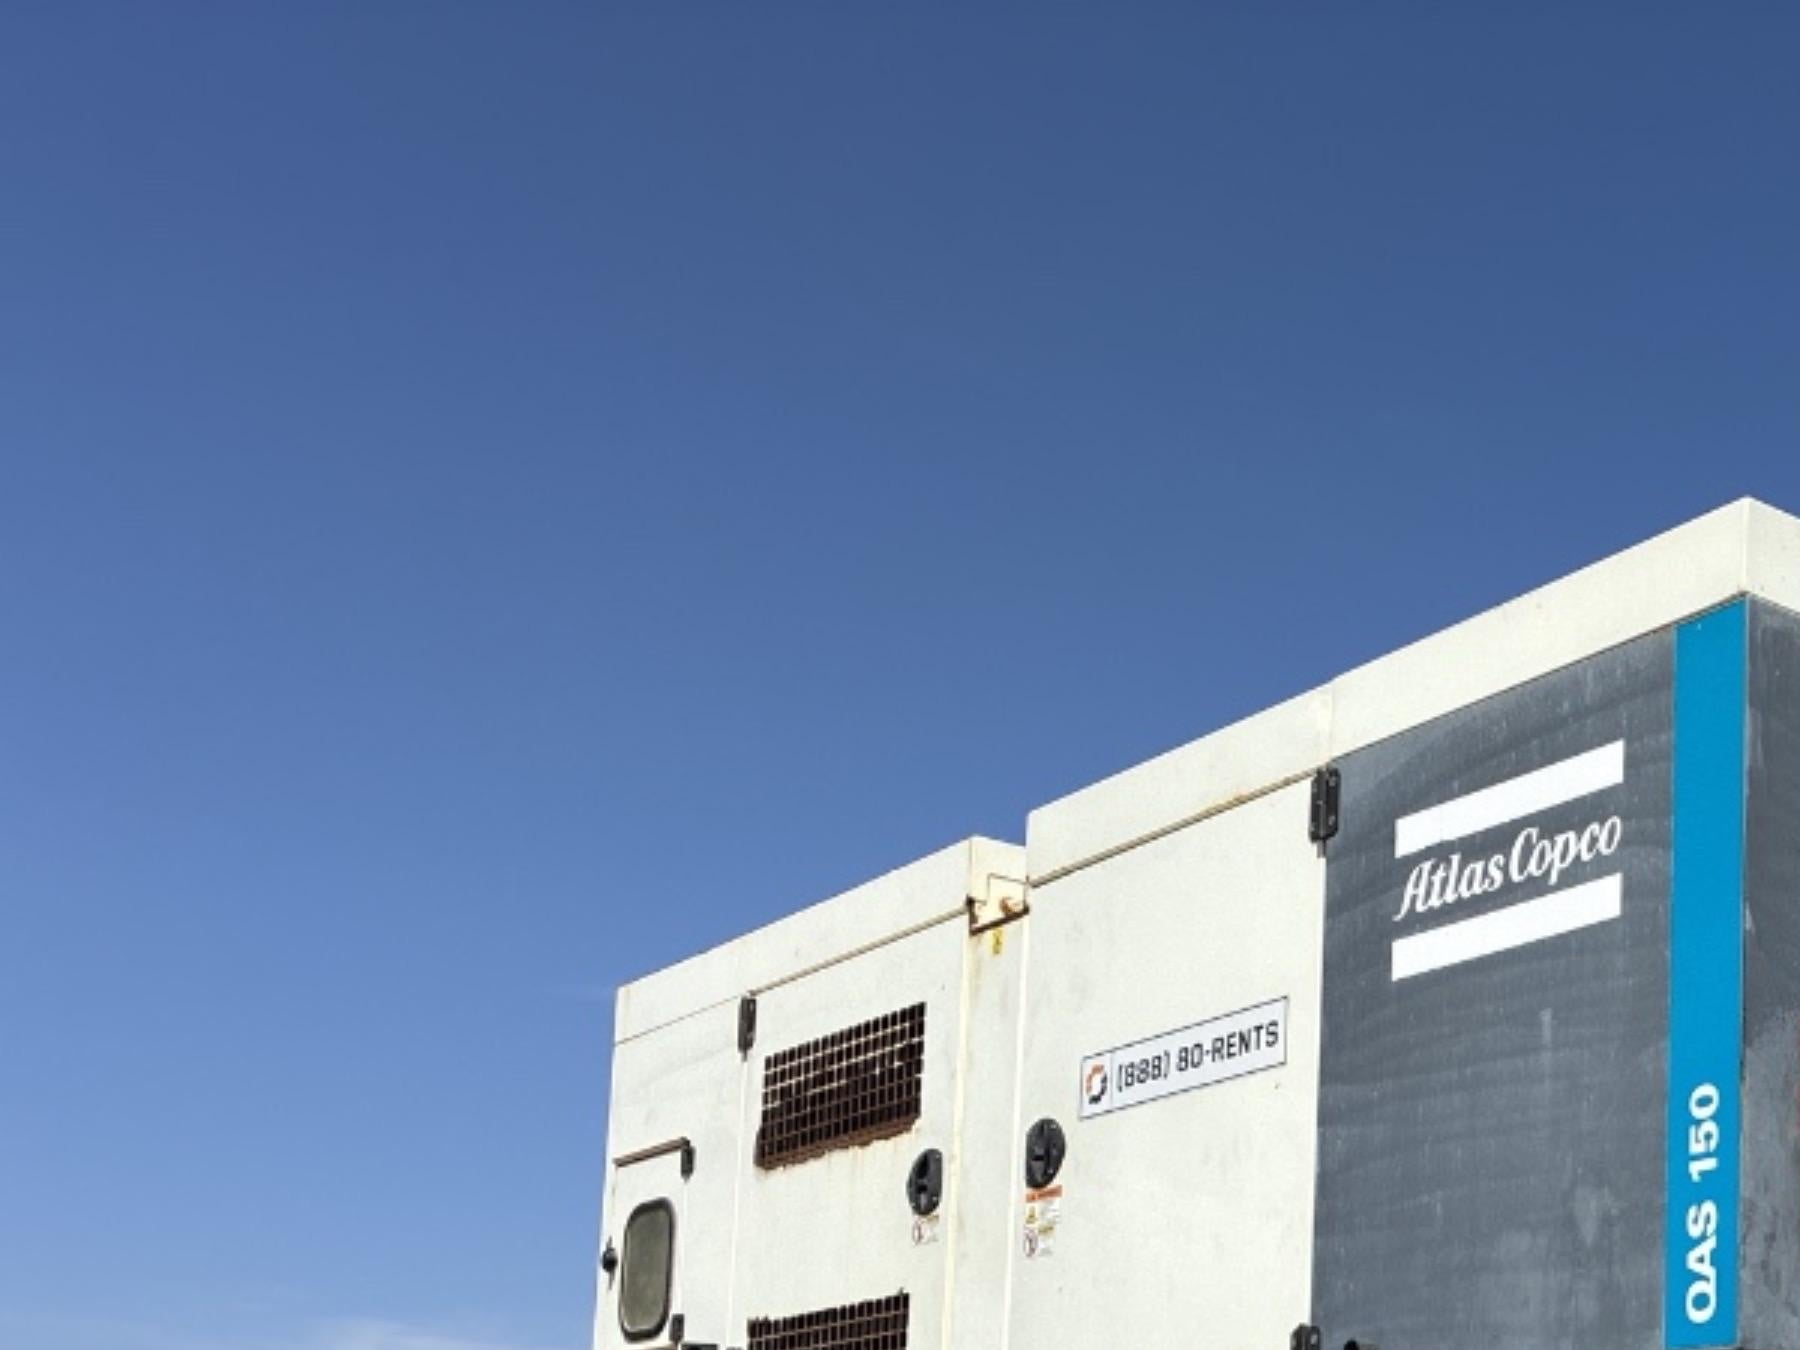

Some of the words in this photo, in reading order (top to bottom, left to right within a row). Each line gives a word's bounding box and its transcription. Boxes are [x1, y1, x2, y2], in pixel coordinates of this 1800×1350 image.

[1392, 851, 1504, 921] Atlas
[1508, 815, 1621, 886] Copco
[1176, 1019, 1279, 1072] 80-RENTS
[1687, 1082, 1721, 1183] 150
